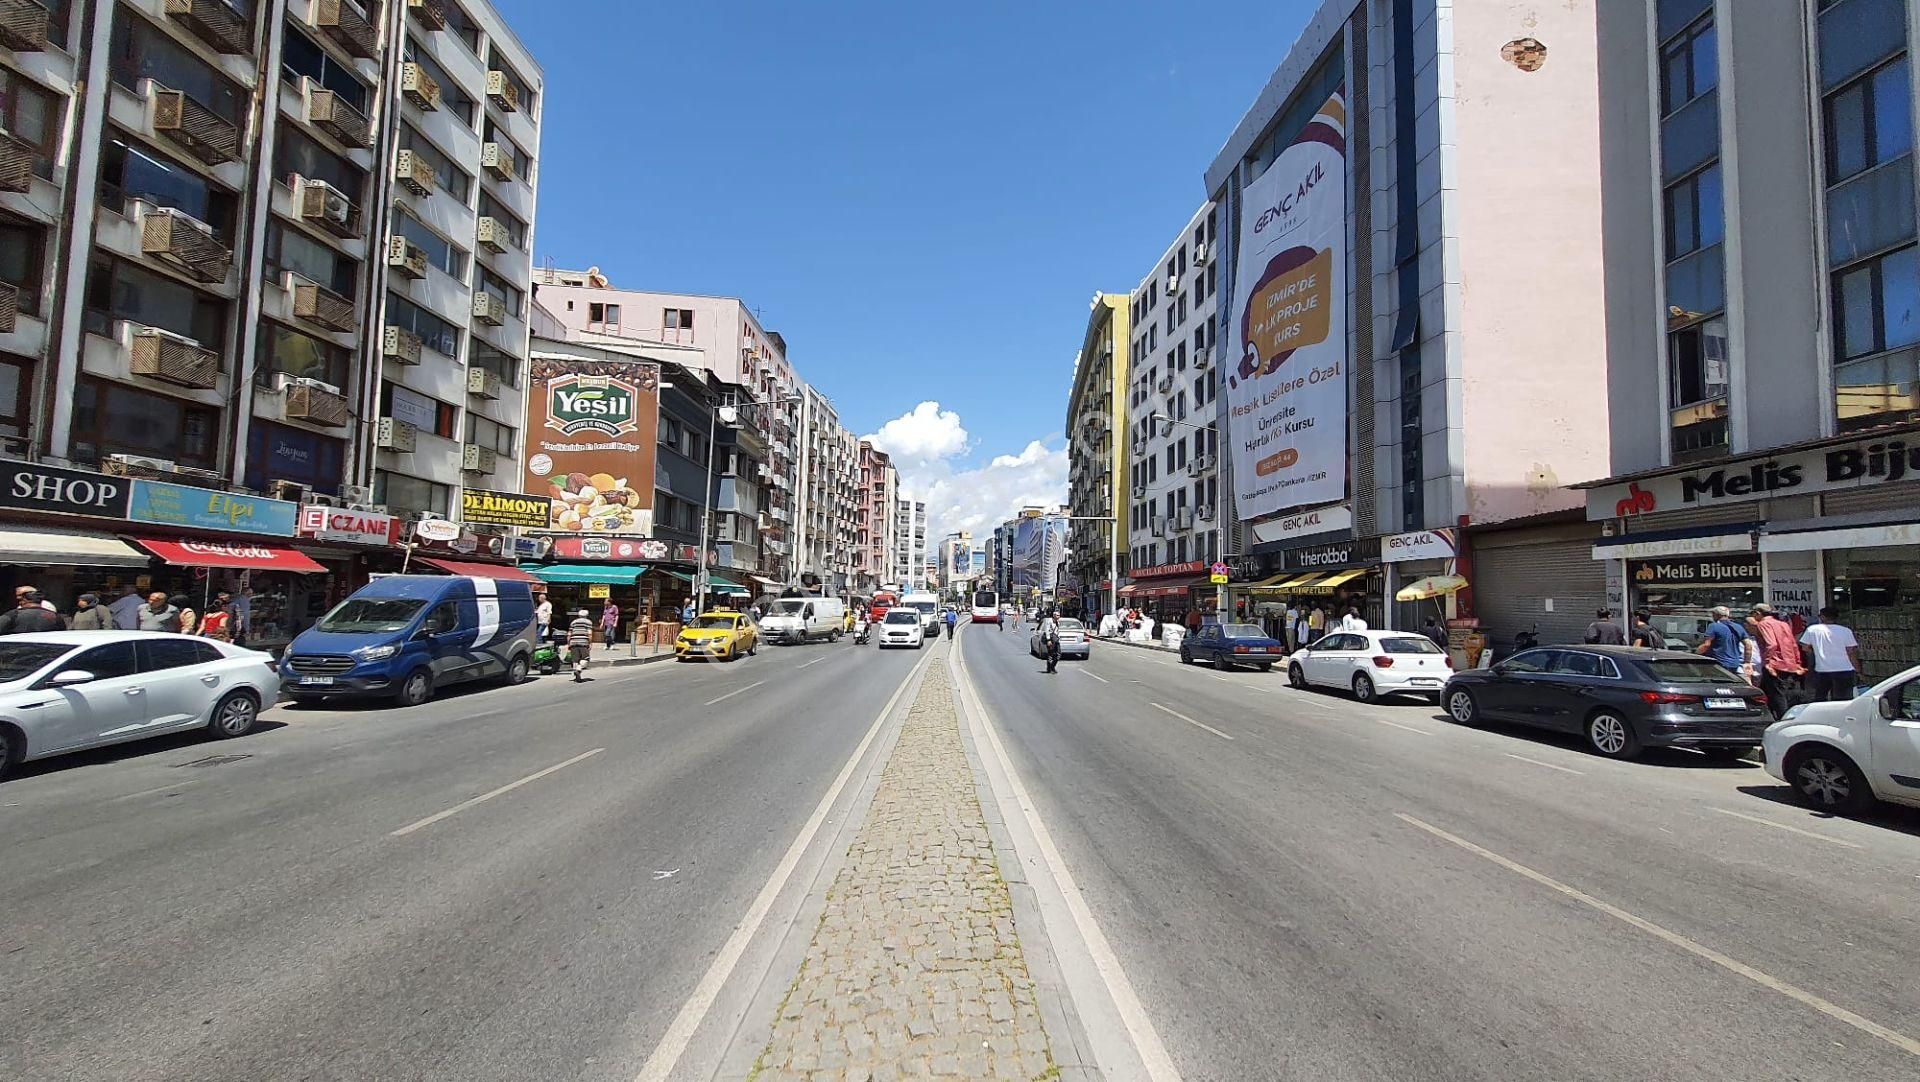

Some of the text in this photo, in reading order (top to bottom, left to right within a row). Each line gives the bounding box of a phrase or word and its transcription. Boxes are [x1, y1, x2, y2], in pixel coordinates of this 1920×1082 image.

[1254, 161, 1325, 233] GENÇ AKIL
[1308, 361, 1341, 384] Özel
[556, 391, 627, 416] Yeşil
[1284, 417, 1315, 434] Kursu
[12, 472, 117, 507] SHOP
[1681, 460, 1803, 503] Melis
[1304, 515, 1322, 527] AKIL
[1300, 548, 1348, 566] therobba
[1163, 562, 1194, 574] TOPTAN
[1656, 560, 1761, 579] Melis Bijuteri
[1772, 588, 1813, 601] İTHALAT
